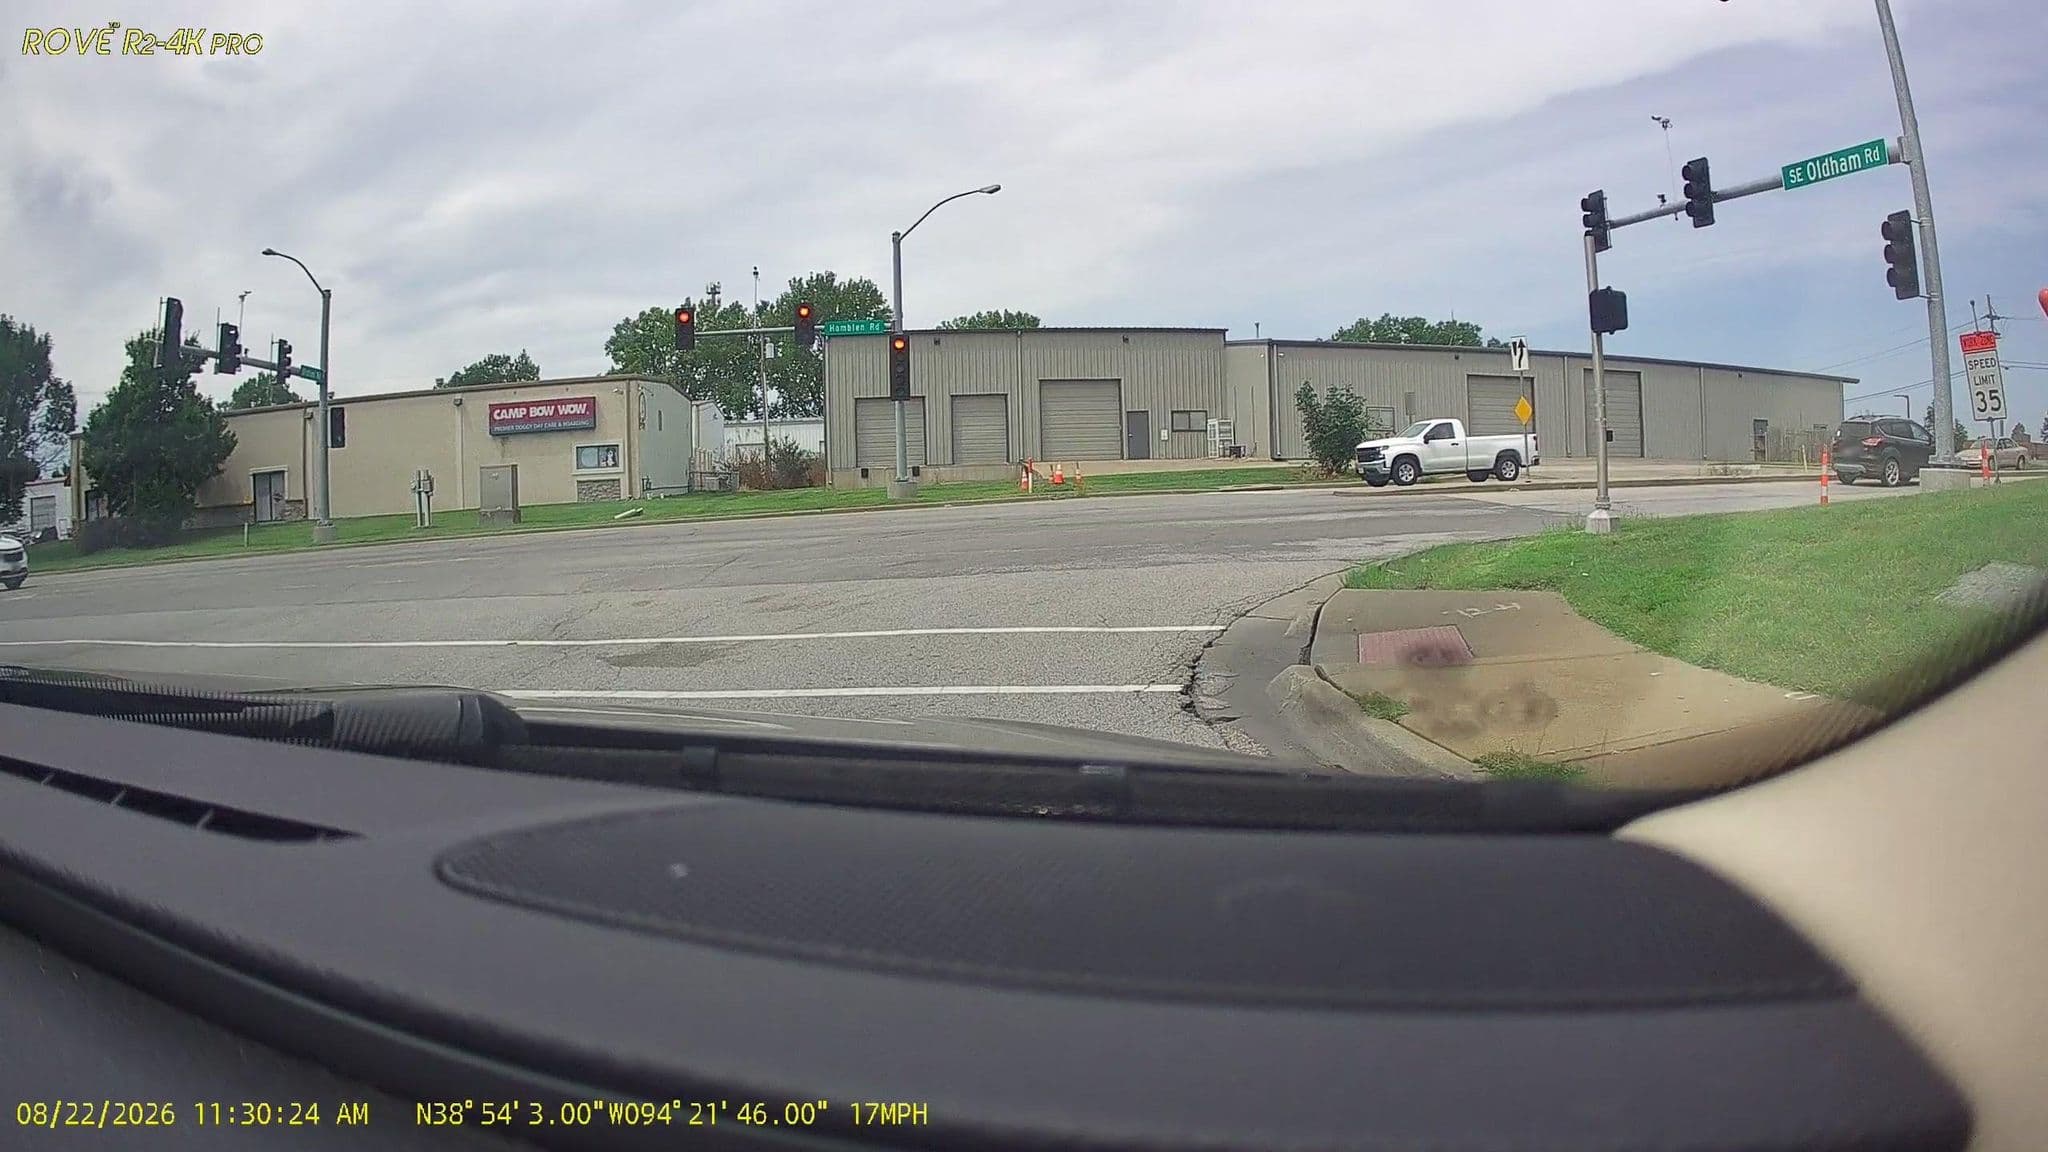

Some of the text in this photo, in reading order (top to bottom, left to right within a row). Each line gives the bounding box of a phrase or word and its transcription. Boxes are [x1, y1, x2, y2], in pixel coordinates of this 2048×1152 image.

[1789, 146, 1880, 184] SE Oldham Rd
[870, 322, 880, 331] Rd
[1968, 357, 1997, 370] SPEED
[1973, 374, 1996, 386] LIMIT
[1975, 389, 2002, 413] 35
[493, 407, 527, 420] CAMP
[529, 405, 555, 417] BOW
